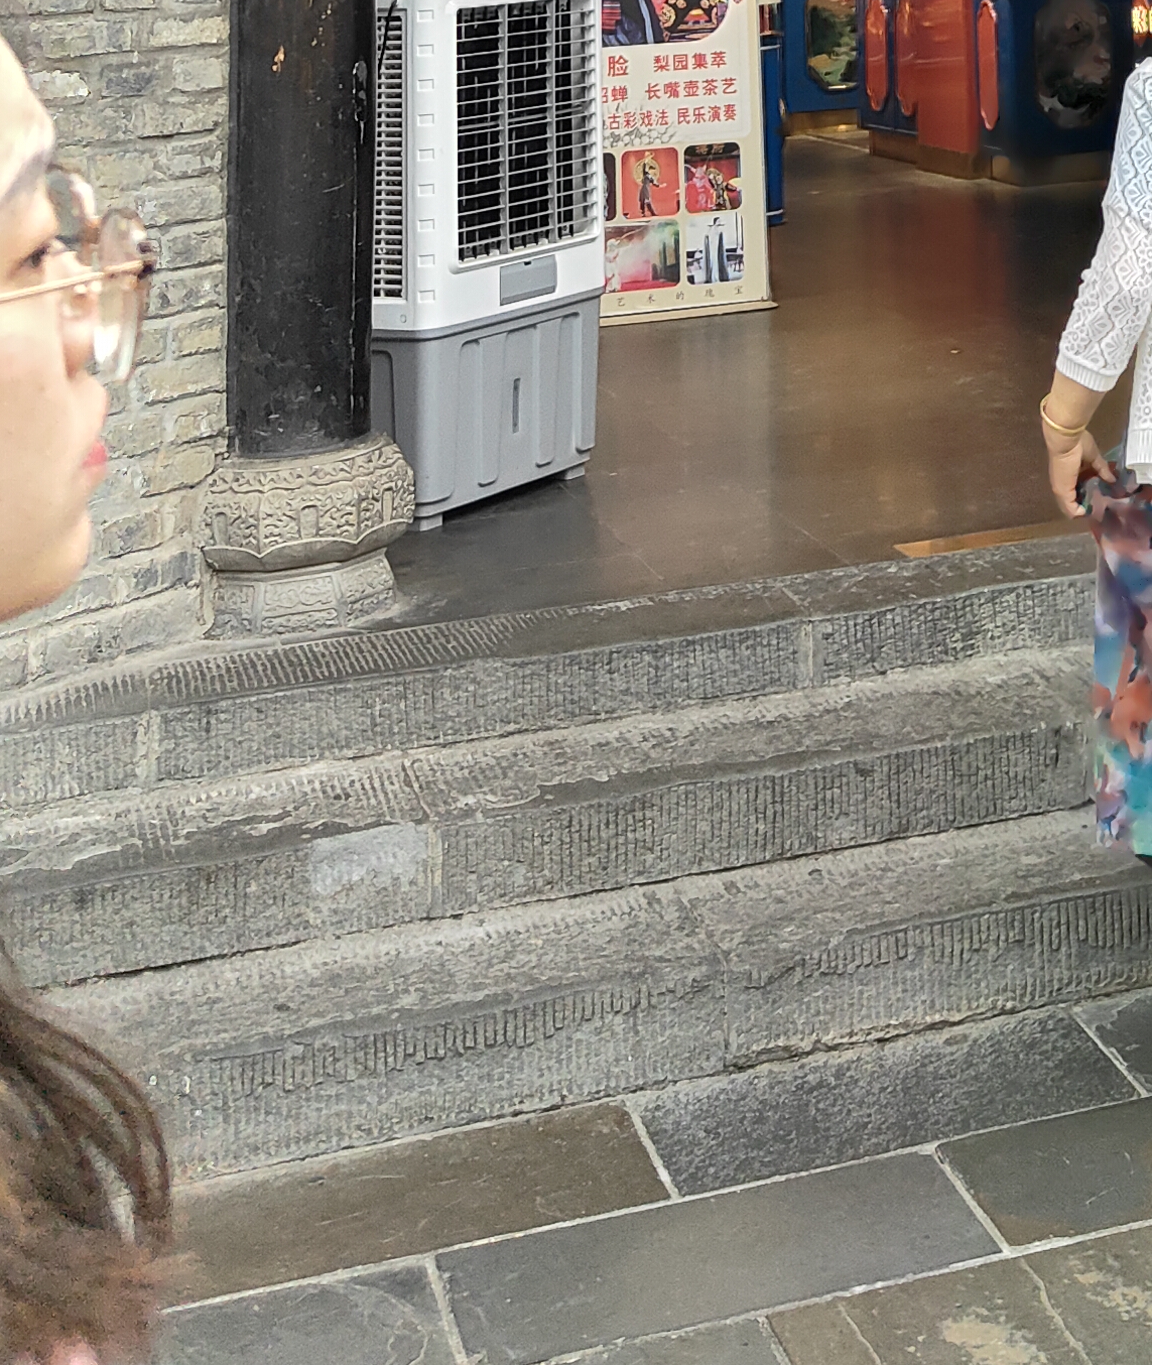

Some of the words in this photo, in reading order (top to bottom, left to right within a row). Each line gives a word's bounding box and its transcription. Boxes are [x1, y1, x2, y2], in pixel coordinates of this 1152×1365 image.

[653, 50, 727, 73] 梨园集萃
[645, 77, 738, 101] 长嘴壶茶艺
[607, 109, 670, 130] 古彩戏法
[677, 103, 737, 126] 民乐演奏
